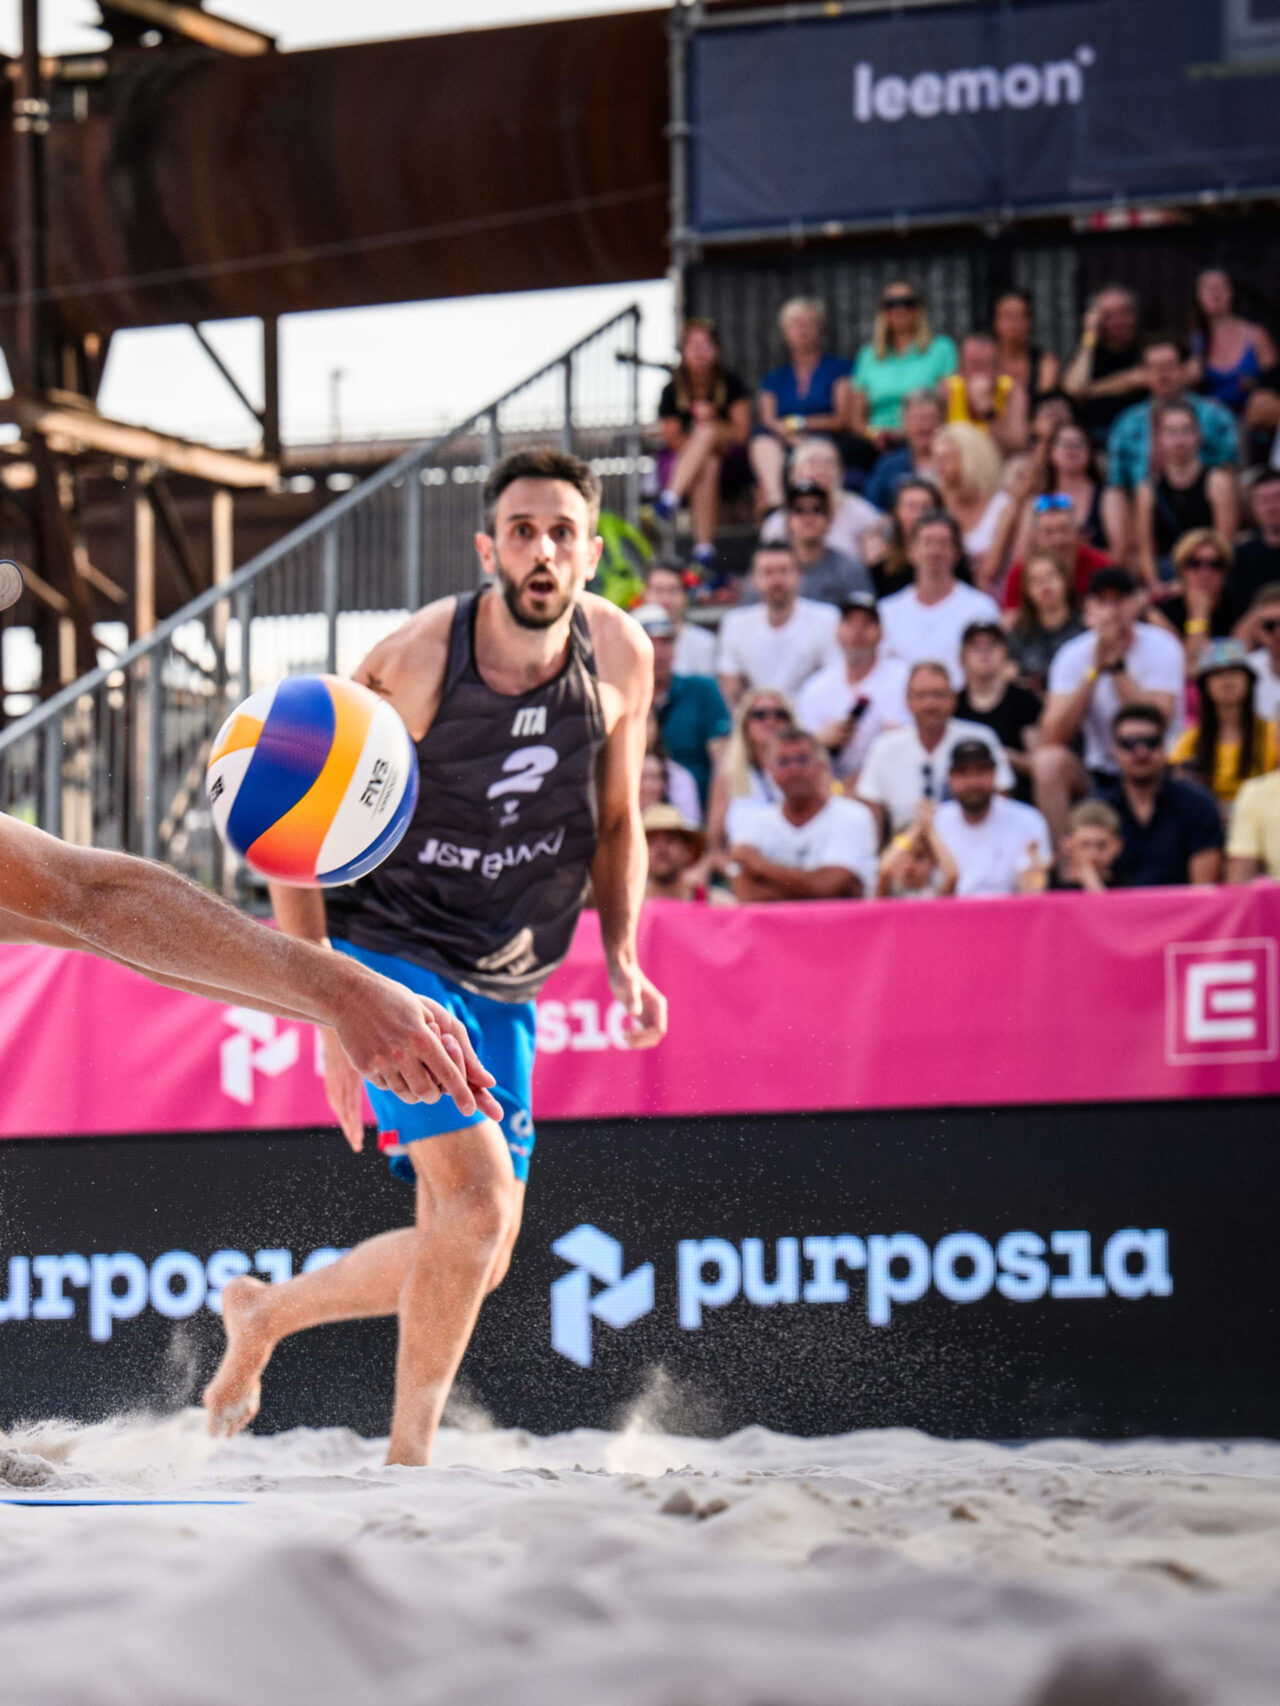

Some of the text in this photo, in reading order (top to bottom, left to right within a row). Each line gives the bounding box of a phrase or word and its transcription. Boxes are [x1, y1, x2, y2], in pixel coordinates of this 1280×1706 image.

[853, 58, 1084, 122] leemon
[510, 705, 548, 738] ITA
[485, 744, 559, 801] 2
[677, 1226, 1174, 1331] purposia
